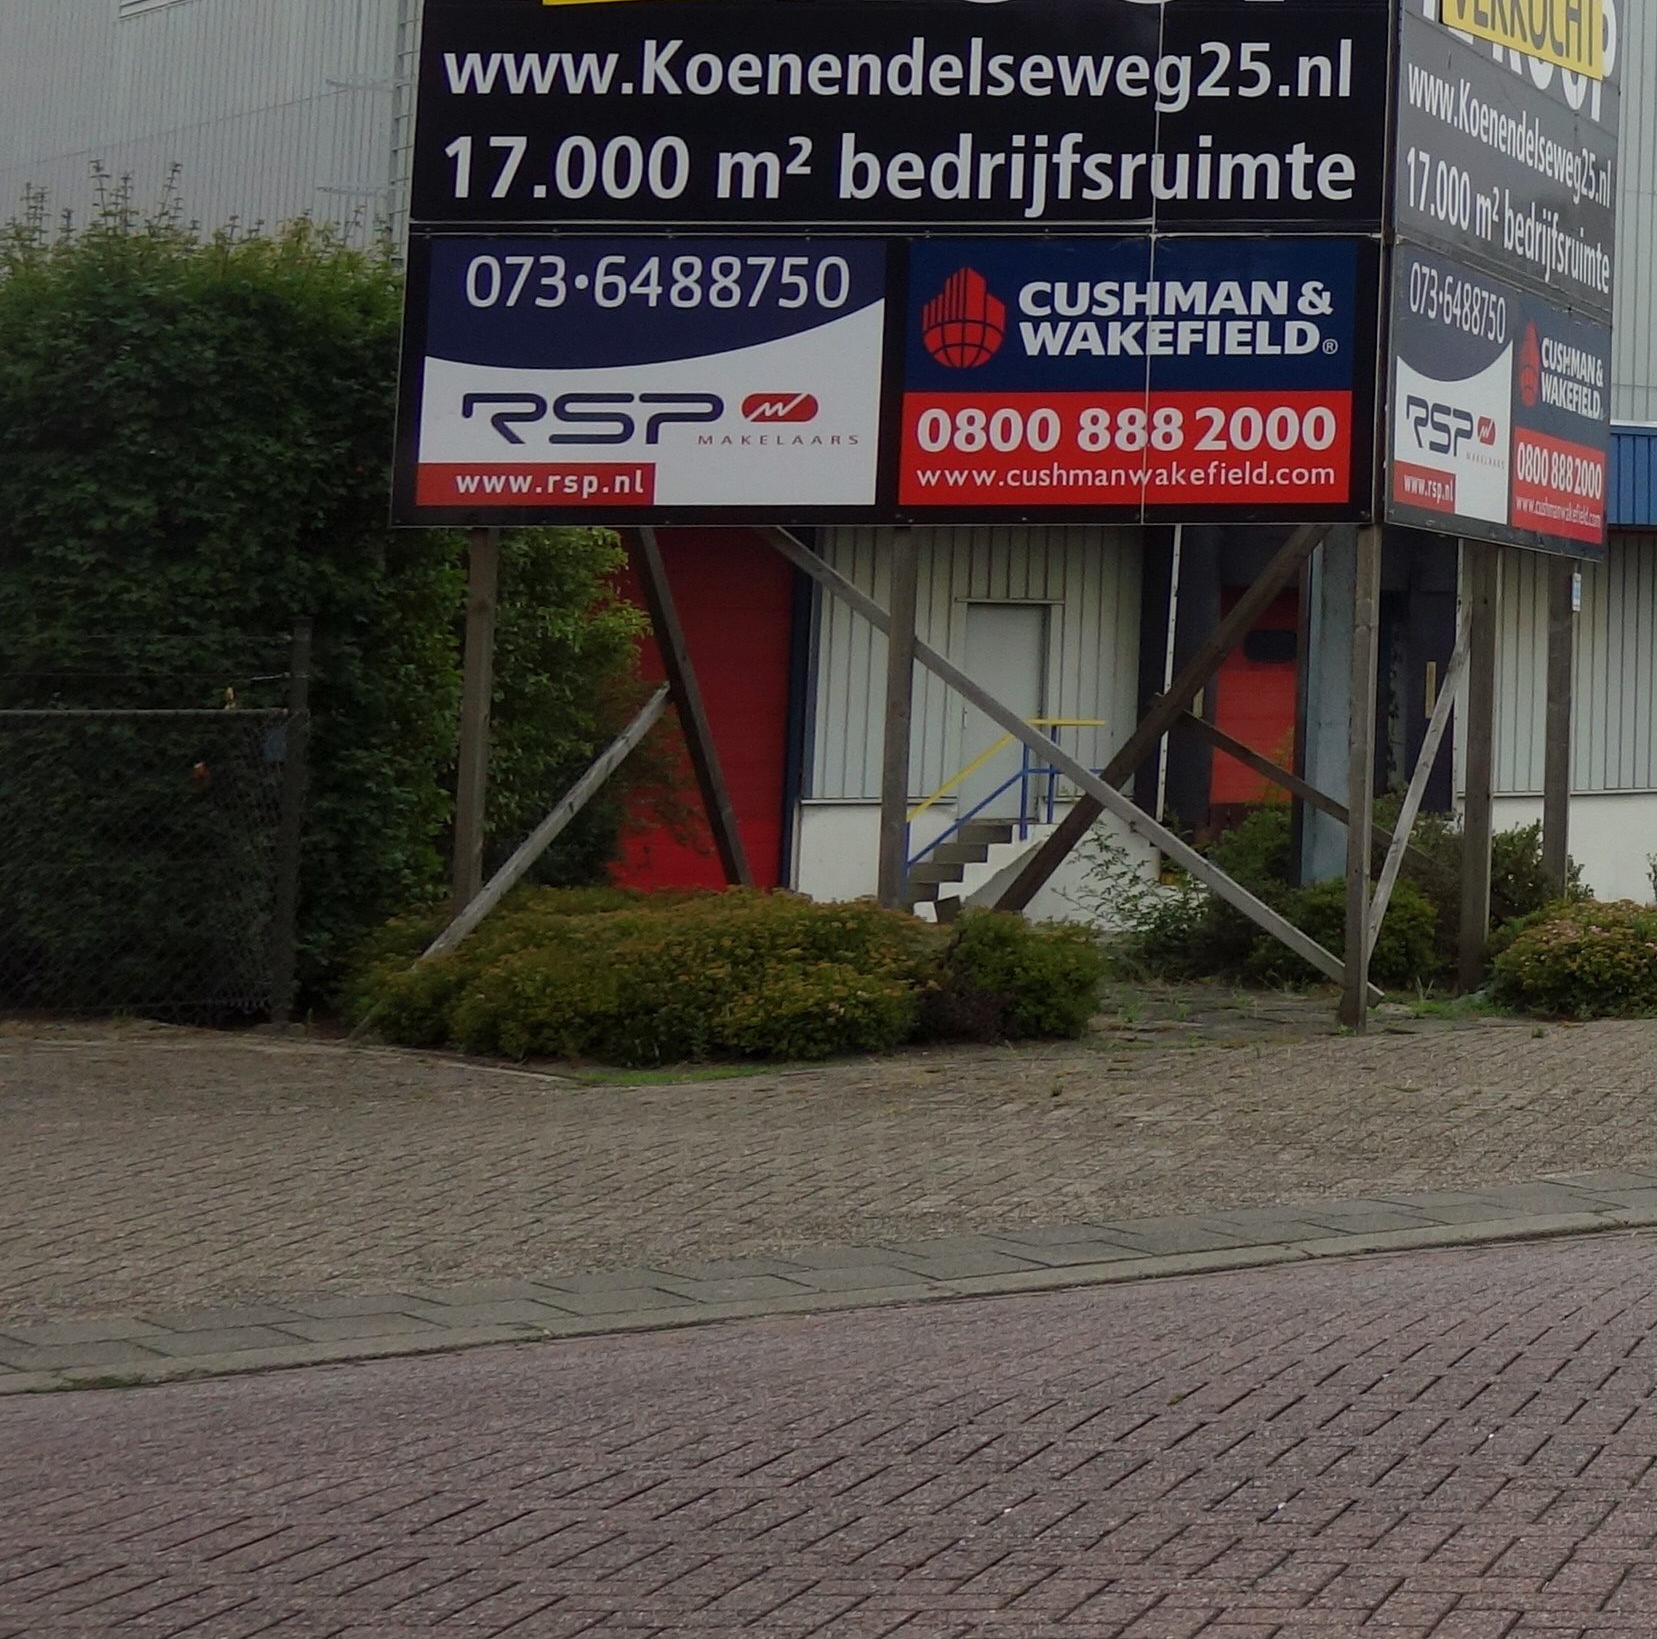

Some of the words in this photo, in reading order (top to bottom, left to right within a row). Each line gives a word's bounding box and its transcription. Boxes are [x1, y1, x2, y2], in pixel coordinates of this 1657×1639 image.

[443, 38, 1352, 113] www.Koenendelseweg25.nl
[1408, 63, 1611, 209] www.Koenendelseweg25.nl
[445, 135, 689, 199] 17.000
[717, 136, 812, 199] m²
[839, 132, 1356, 223] bedrijfsruimte
[1406, 147, 1471, 231] 17.000
[1476, 186, 1500, 242] m²
[1503, 189, 1610, 295] bedrijfsruimte
[1018, 280, 1289, 316] CUSHMAN
[1297, 280, 1334, 315] &
[1541, 337, 1596, 384] CUSHMAN
[1595, 359, 1604, 388] &
[460, 392, 725, 445] RSP
[697, 434, 859, 446] MAKELAARS
[917, 408, 1061, 452] 0800
[1077, 407, 1184, 451] 888
[1194, 406, 1336, 451] 2000
[1406, 394, 1474, 457] RSP
[457, 470, 643, 499] www.rsp.nl
[917, 461, 1335, 487] www.cushmanwakefield.com
[1403, 474, 1454, 504] www.rsp.nl
[1517, 442, 1549, 487] 0800
[1551, 451, 1574, 492] 888
[1574, 461, 1603, 500] 2000
